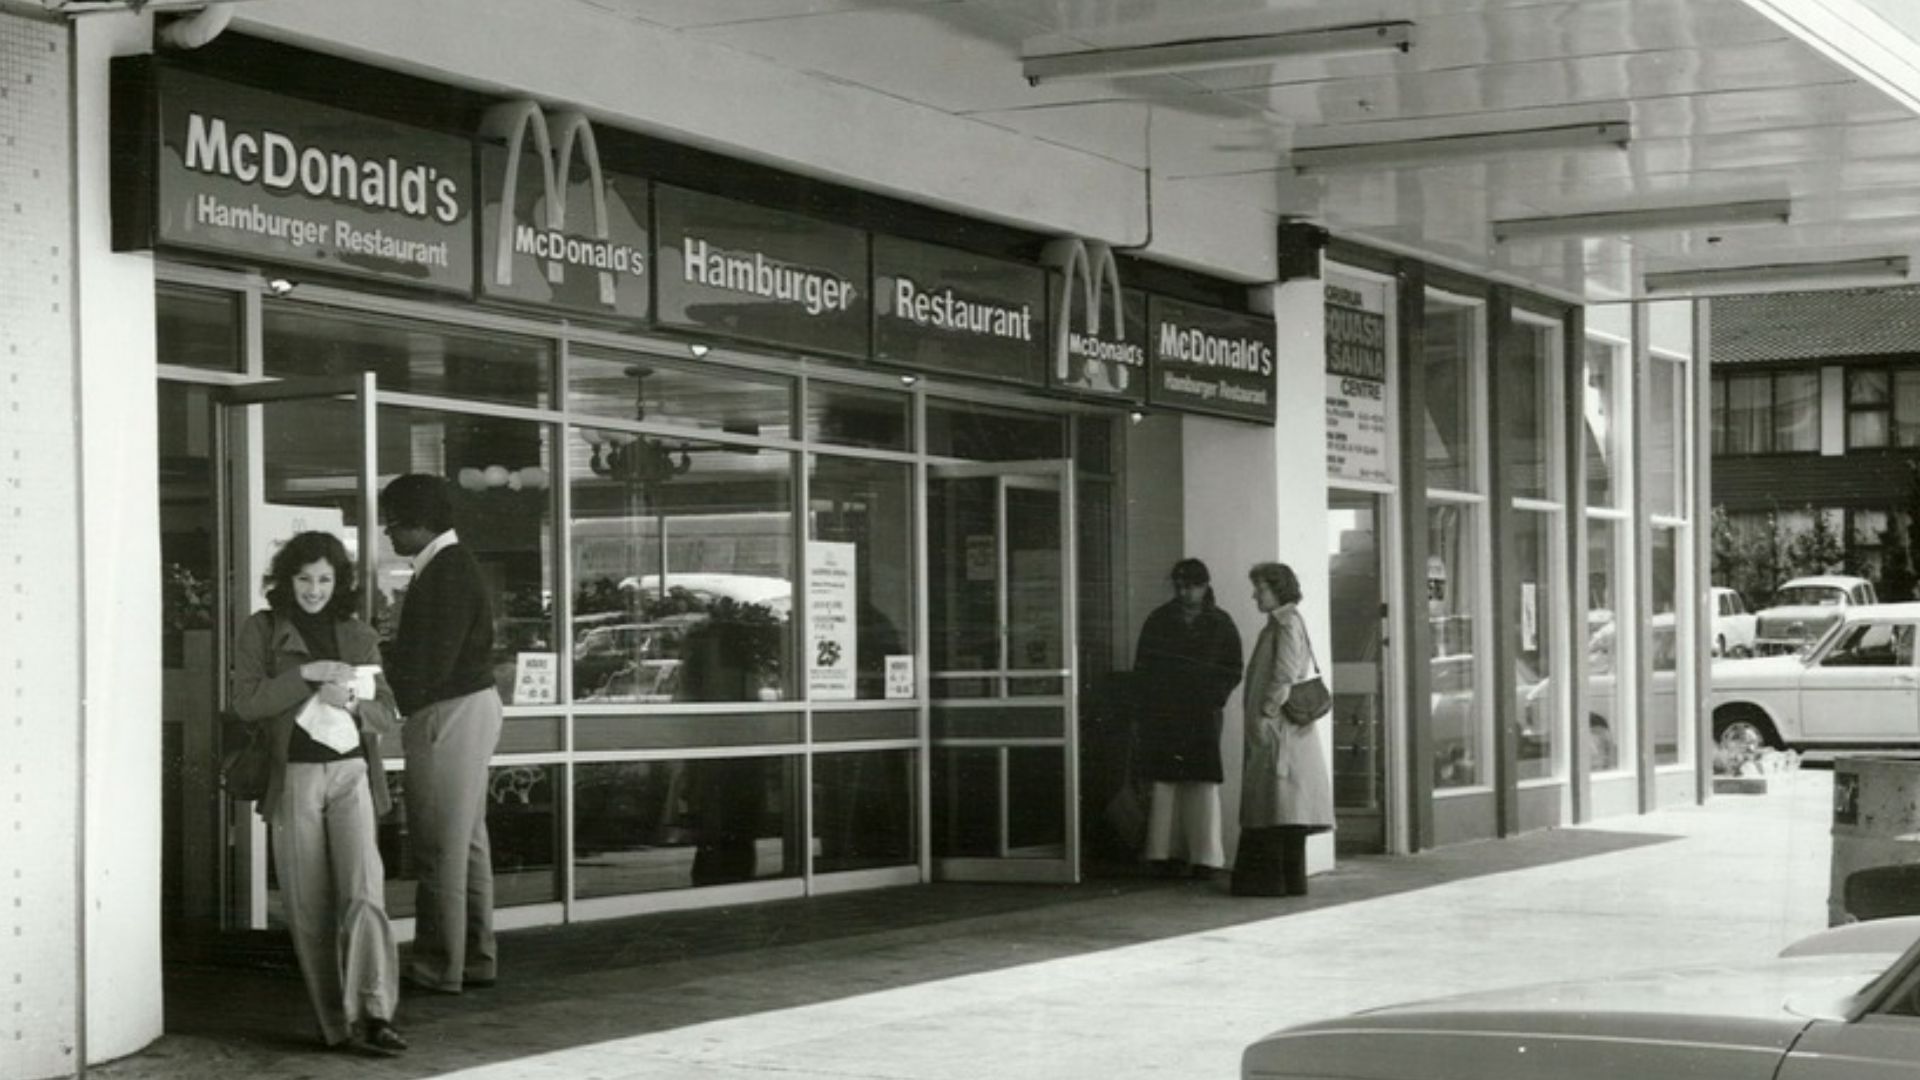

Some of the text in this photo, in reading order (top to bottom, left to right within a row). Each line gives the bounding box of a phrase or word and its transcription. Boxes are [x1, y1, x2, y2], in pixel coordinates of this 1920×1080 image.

[185, 114, 459, 222] McDonald's
[198, 194, 448, 267] Hamburger Restaurant
[516, 225, 644, 275] McDonald's
[683, 237, 853, 316] Hamburger
[895, 278, 1032, 341] Restaurant
[1325, 306, 1384, 350] QUASH
[1069, 332, 1144, 367] McDonald's
[1160, 321, 1272, 376] McDonald's
[1341, 378, 1381, 401] CENTRE
